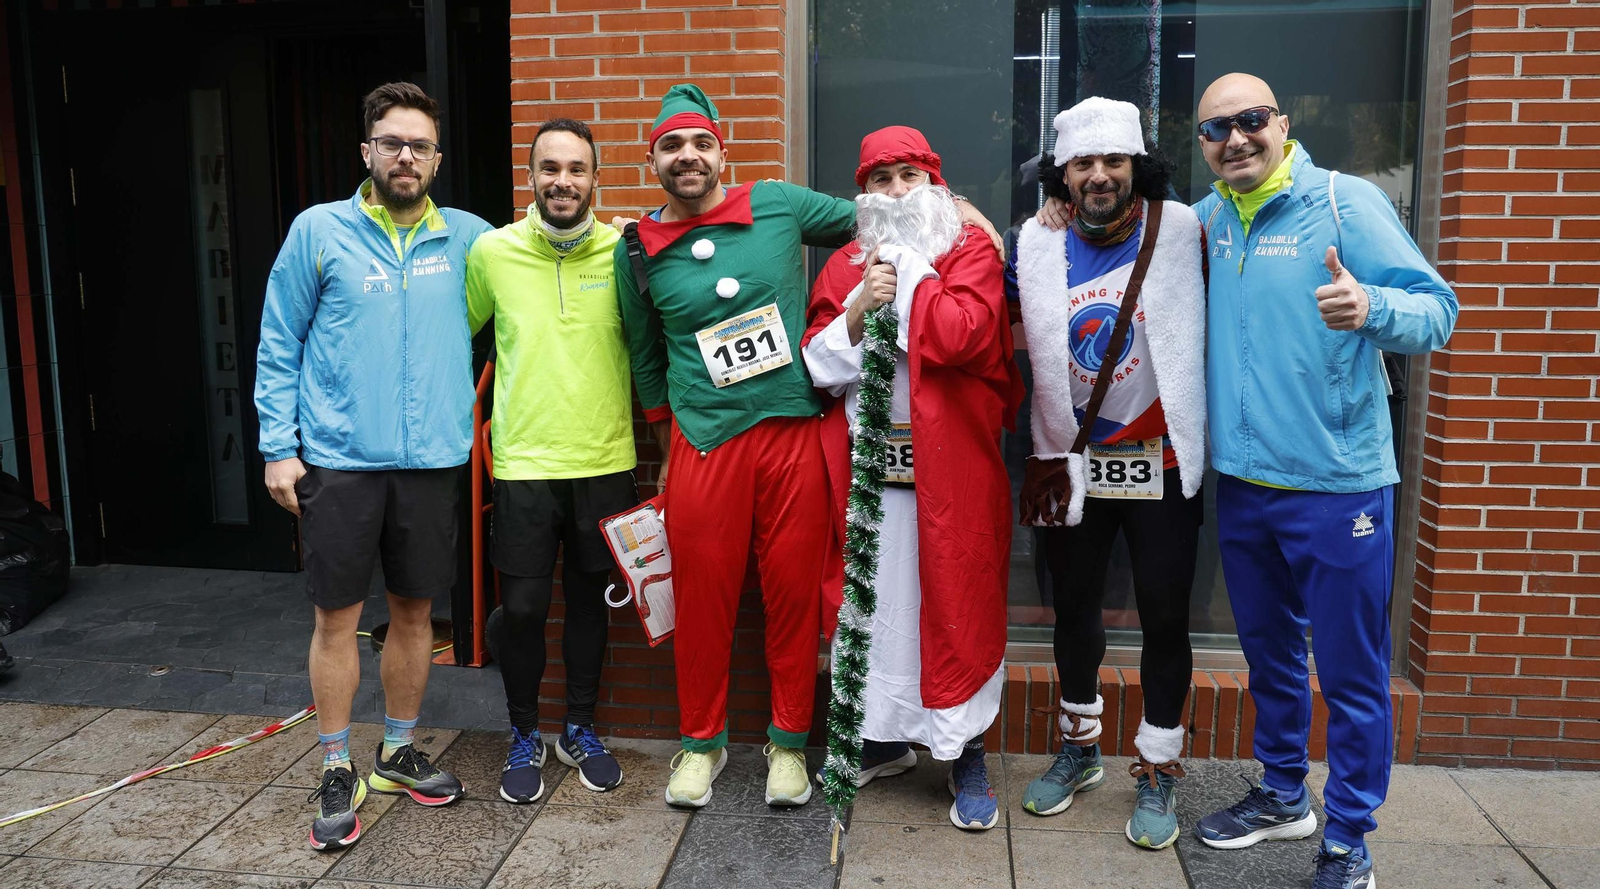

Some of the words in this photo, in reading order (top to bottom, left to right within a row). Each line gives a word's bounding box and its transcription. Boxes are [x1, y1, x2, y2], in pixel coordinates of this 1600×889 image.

[1259, 235, 1298, 245] BAJADILLA
[1254, 246, 1298, 257] RUNNING
[413, 255, 447, 266] BAJADILLA
[412, 263, 451, 276] RUNNING
[200, 153, 243, 462] MARIETA
[713, 329, 778, 368] 191
[1352, 528, 1375, 538] luanvi
